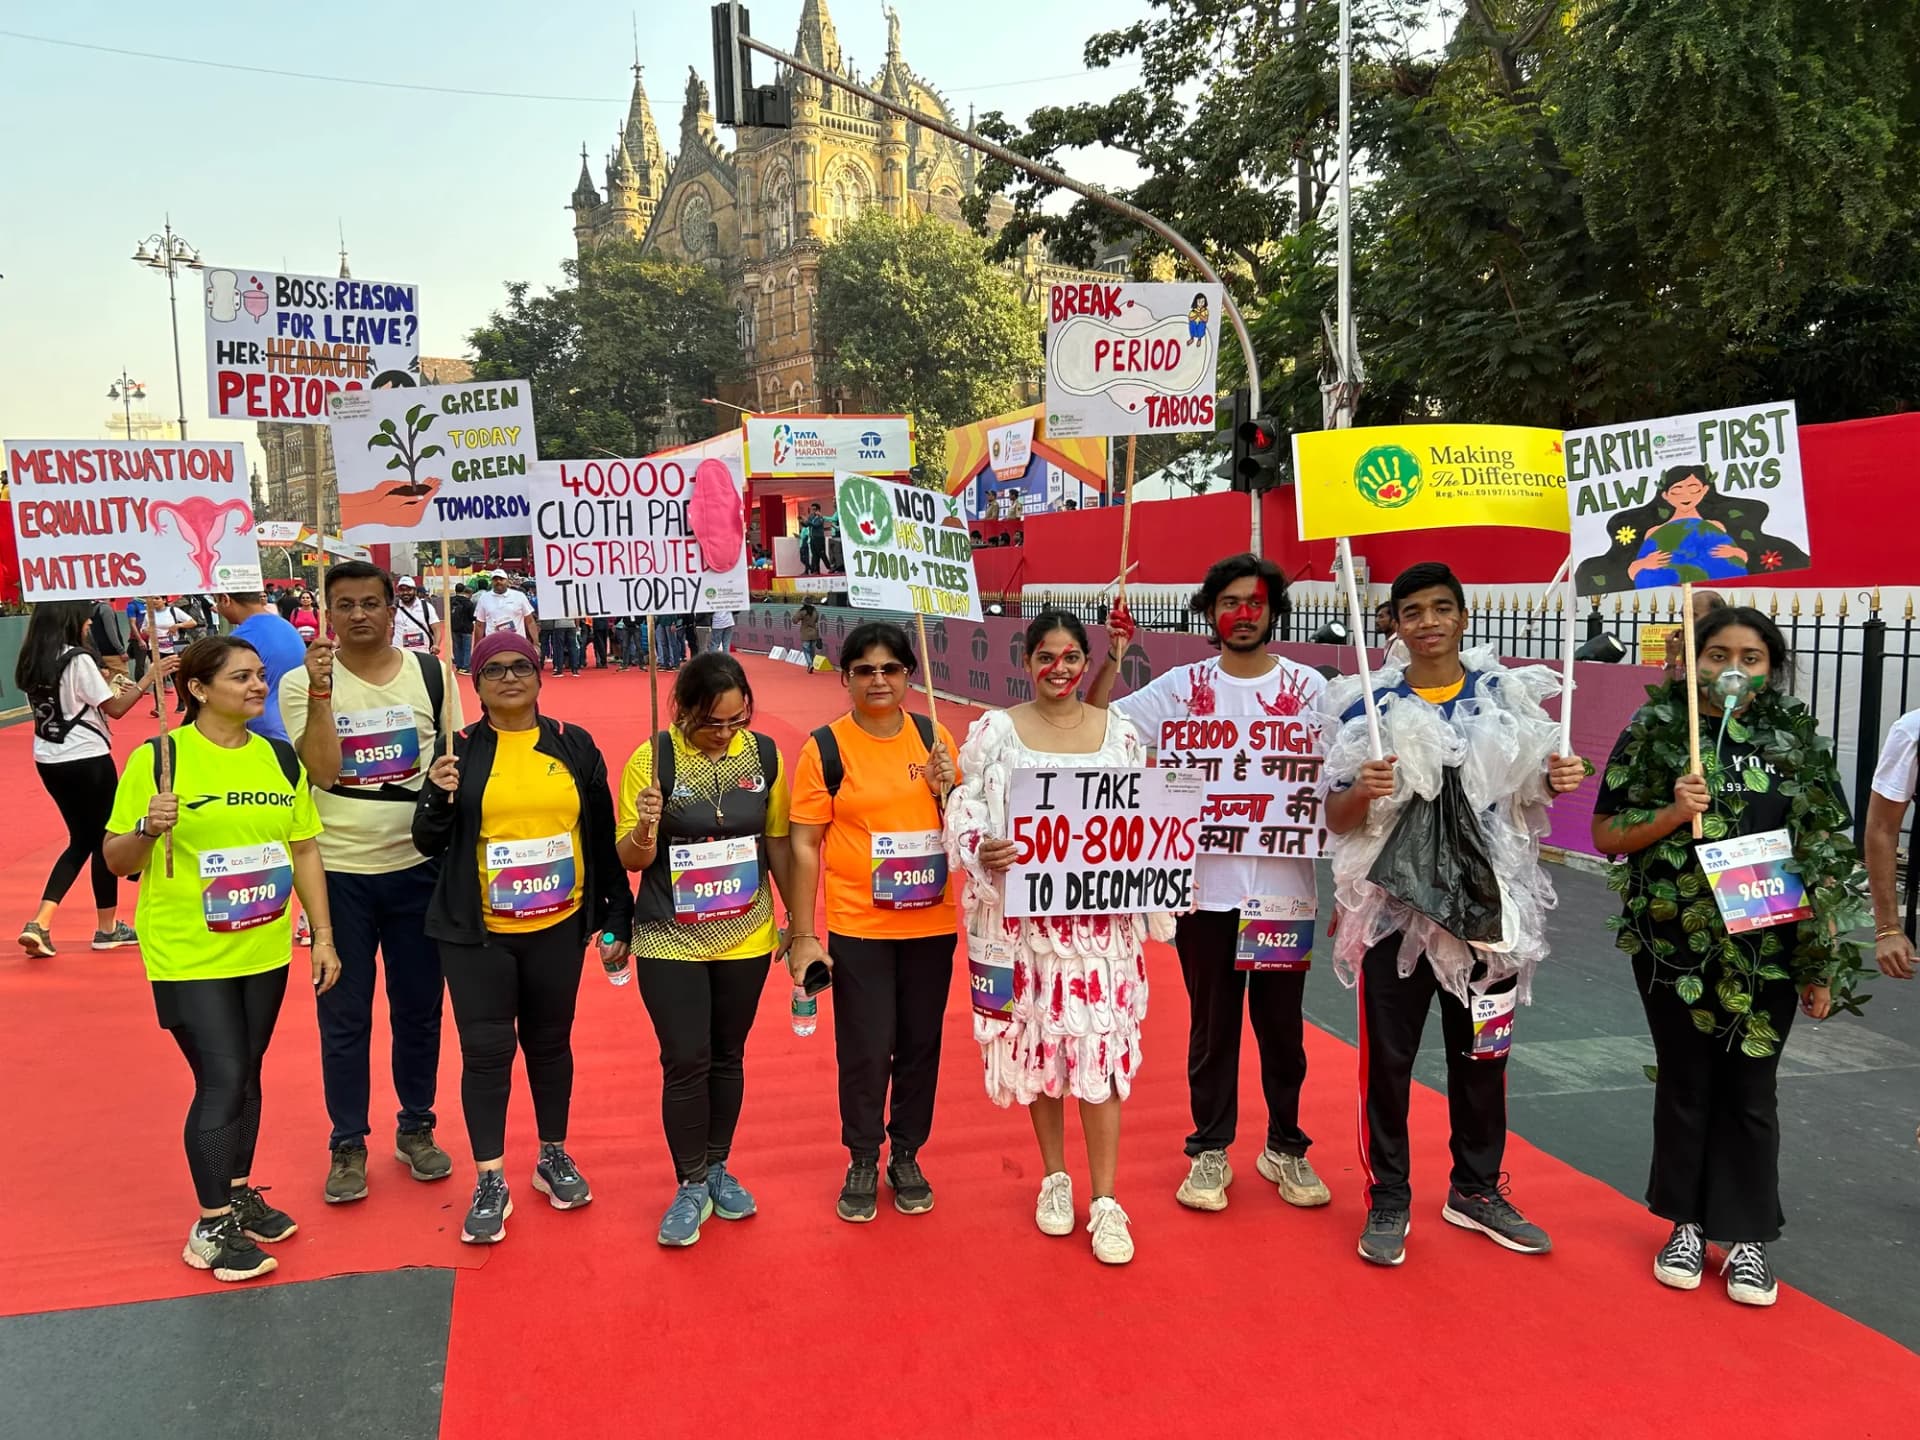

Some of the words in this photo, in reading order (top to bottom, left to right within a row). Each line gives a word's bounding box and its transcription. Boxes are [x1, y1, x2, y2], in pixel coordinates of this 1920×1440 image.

[336, 281, 414, 313] REASON
[1051, 284, 1122, 324] BREAK
[276, 312, 316, 339] FOR
[324, 314, 418, 347] LEAVE?
[216, 340, 267, 365] HER:
[267, 337, 371, 378] HEADACHE
[1095, 338, 1181, 372] PERIOD
[442, 386, 519, 415] GREEN
[1145, 394, 1214, 428] TABOOS
[447, 426, 521, 449] TODAY
[794, 431, 818, 439] TATA
[1565, 427, 1653, 482] EARTH
[1698, 408, 1790, 462] FIRST
[11, 448, 234, 485] MENSTRUATION
[795, 448, 837, 456] MARATHON
[858, 450, 885, 459] TATA
[1429, 445, 1515, 469] Making
[451, 454, 526, 482] GREEN
[1429, 471, 1460, 488] The
[1461, 466, 1567, 489] Difference
[18, 497, 149, 539] EQUALITY
[537, 500, 633, 540] CLOTH
[894, 488, 935, 524] NGO
[893, 518, 924, 553] HAS
[923, 526, 973, 563] PLANTED
[23, 552, 146, 592] MATTERS
[853, 550, 919, 581] 17,000+
[921, 560, 969, 592] TREES
[555, 579, 617, 617] TILL
[619, 577, 702, 613] TODAY
[907, 584, 938, 614] TILL
[933, 589, 970, 617] TODAY
[931, 661, 950, 681] TATA
[968, 670, 991, 692] TATA
[1006, 677, 1032, 699] TATA
[1161, 719, 1239, 750] PERIOD
[354, 743, 403, 764] 83559
[1233, 749, 1252, 782] है
[1036, 772, 1057, 810] I
[1075, 772, 1142, 810] TAKE
[1286, 786, 1323, 825] की
[1014, 814, 1145, 865] 500-800
[1148, 815, 1198, 862] YRS
[1198, 825, 1250, 854] क्या
[492, 858, 513, 866] TATA
[673, 860, 694, 868] TATA
[1706, 859, 1730, 869] TATA
[512, 874, 560, 896] 93069
[694, 878, 742, 899] 98789
[894, 868, 935, 886] 93068
[1025, 872, 1053, 912] TO
[1066, 867, 1192, 911] DECOMPOSE
[228, 883, 276, 906] 98790
[1257, 932, 1298, 947] 94322
[970, 972, 994, 995] 321
[1477, 1010, 1497, 1018] TATA
